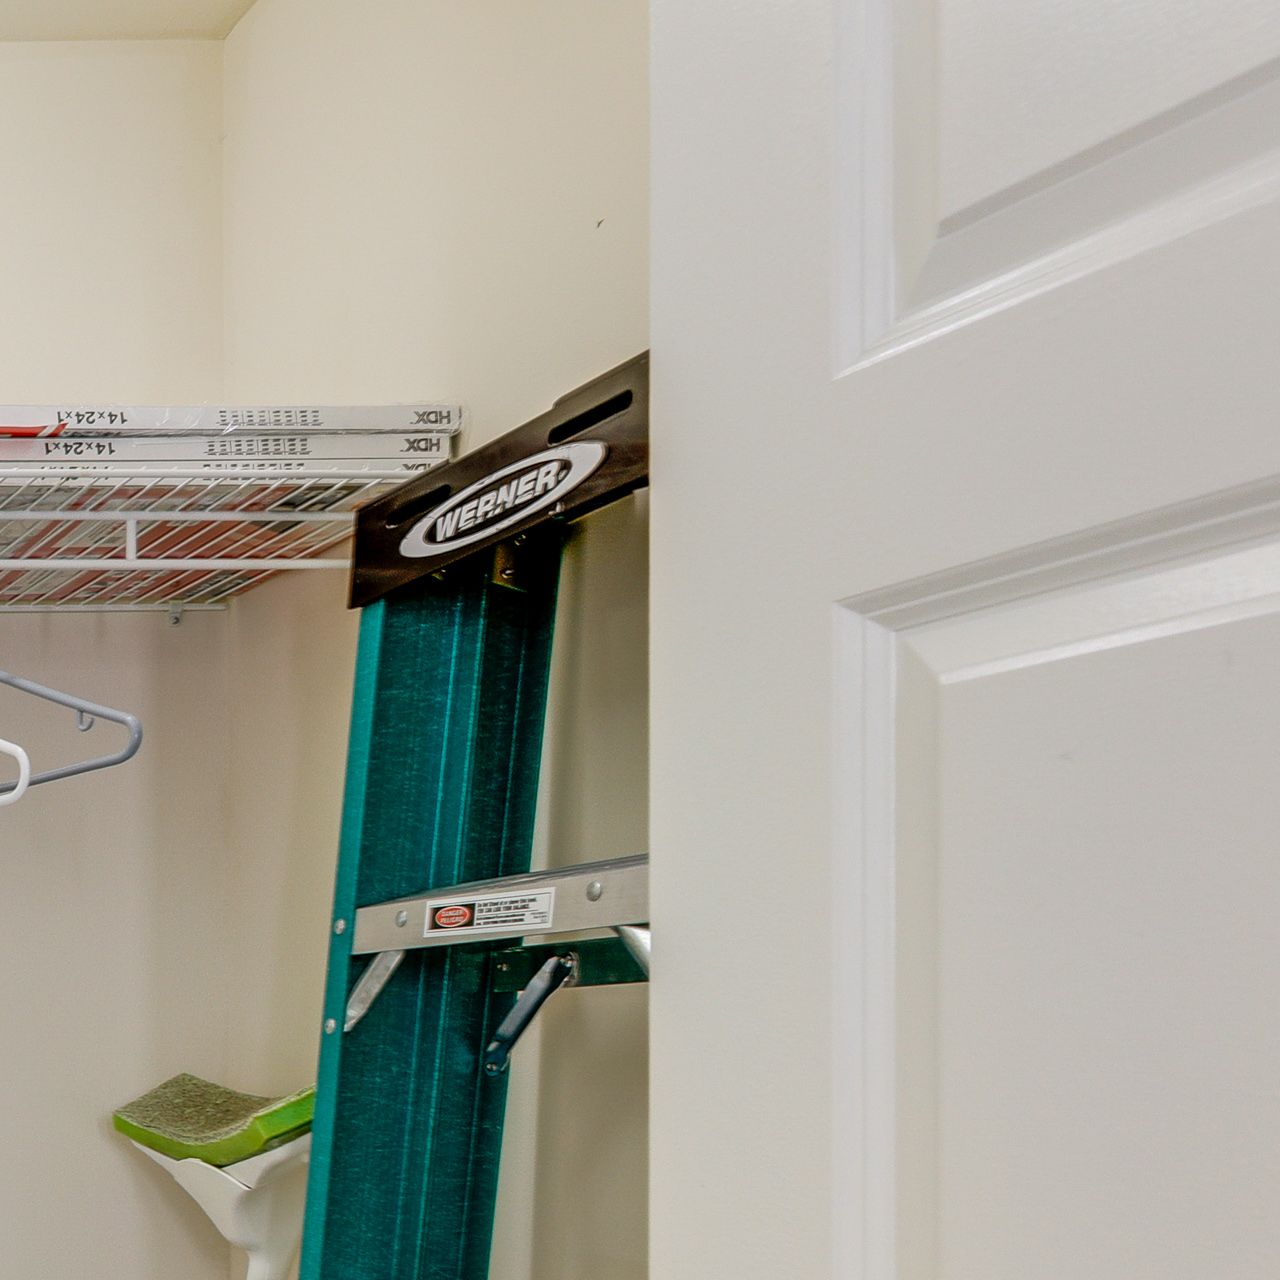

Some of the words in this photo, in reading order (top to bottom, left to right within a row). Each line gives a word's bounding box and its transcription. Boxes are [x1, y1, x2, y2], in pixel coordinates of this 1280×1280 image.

[413, 410, 451, 424] HDX
[45, 442, 116, 455] 14x24x1
[403, 438, 441, 452] HDX
[436, 460, 561, 542] WERNER
